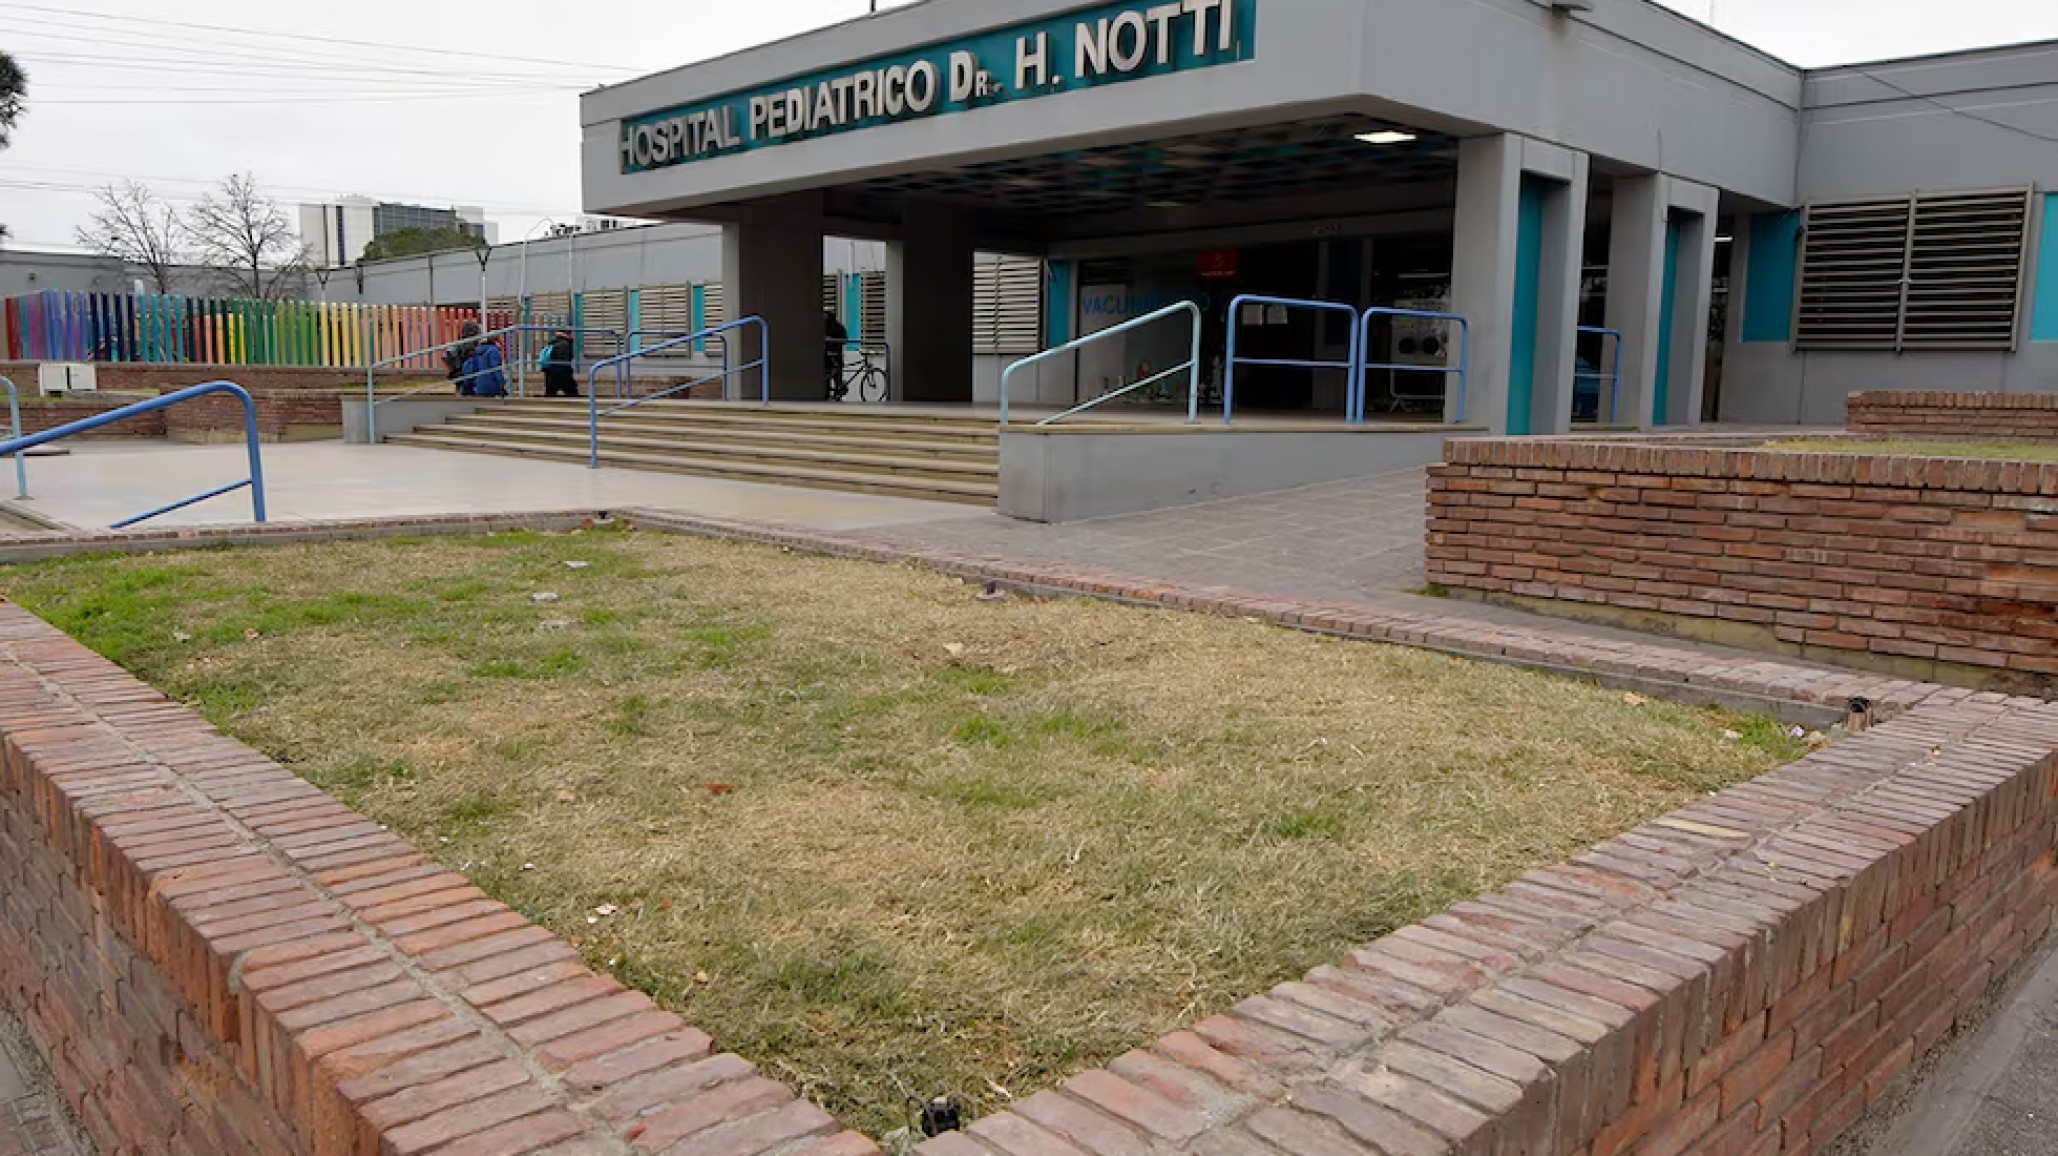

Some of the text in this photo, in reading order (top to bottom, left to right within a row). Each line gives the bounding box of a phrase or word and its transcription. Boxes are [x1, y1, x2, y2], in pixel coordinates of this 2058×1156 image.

[619, 105, 740, 166] HOSPITAL
[750, 59, 936, 140] PEDIATRICO
[1016, 31, 1061, 90] H.
[1074, 0, 1231, 79] NOTTI
